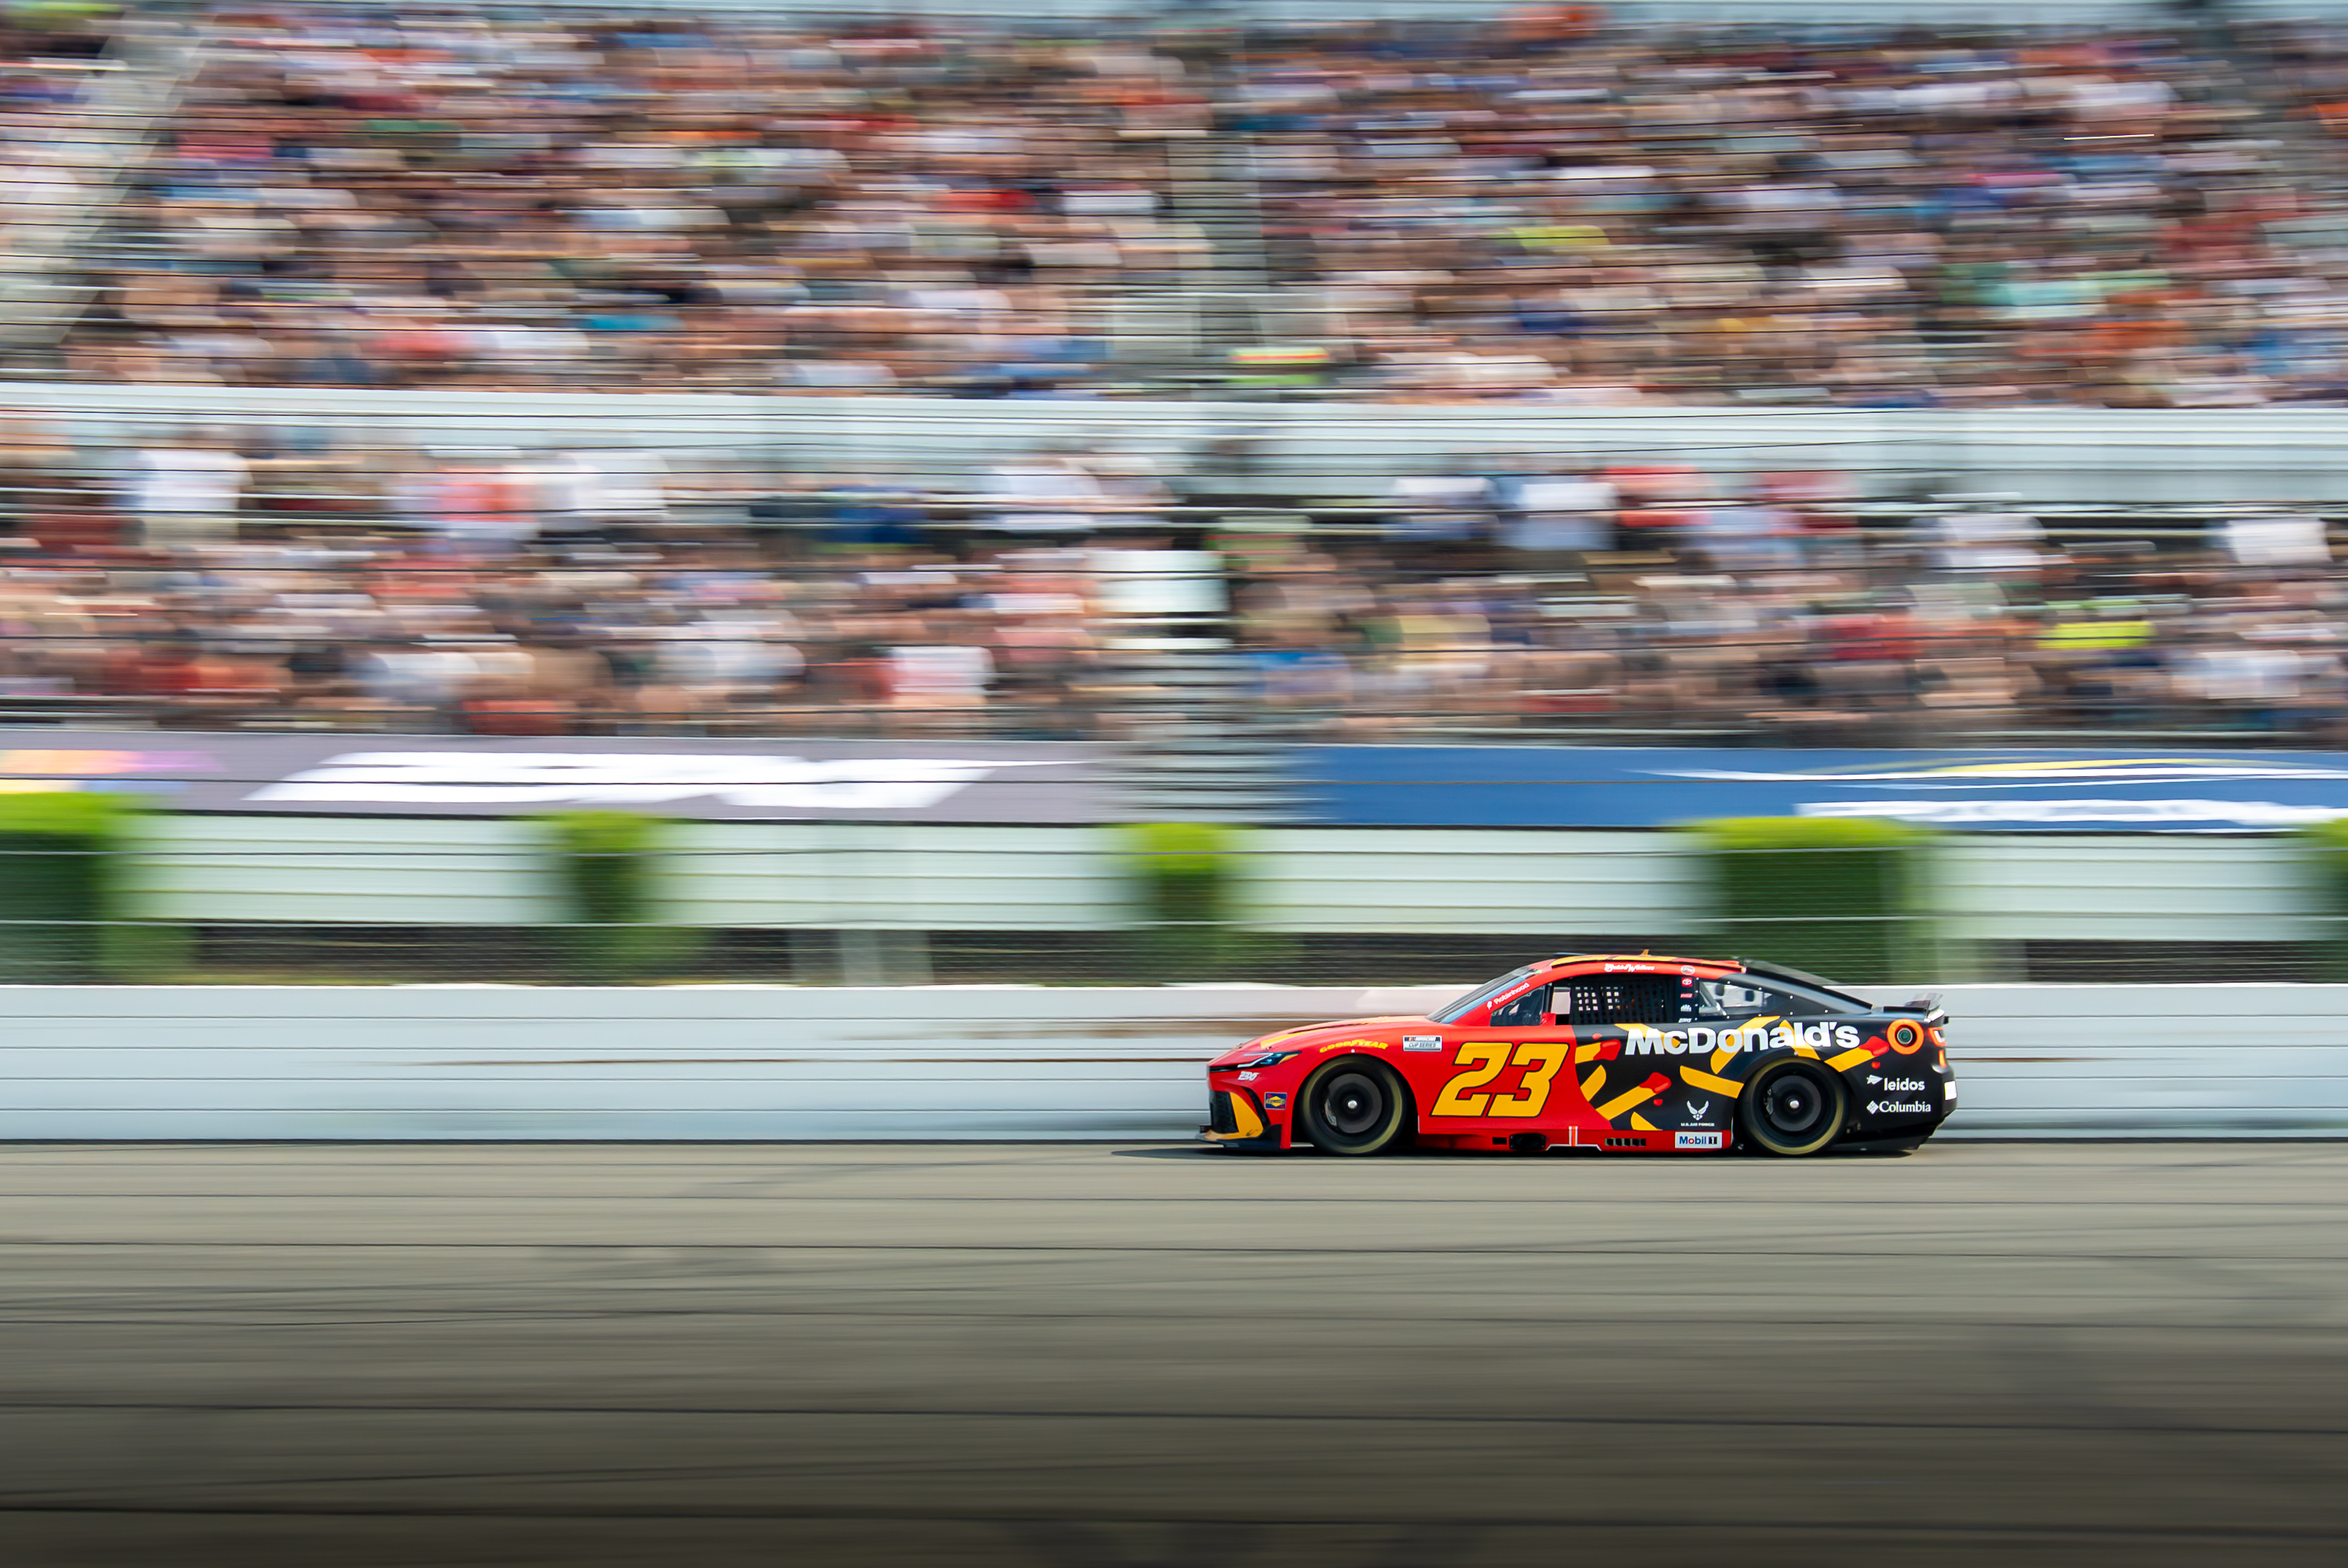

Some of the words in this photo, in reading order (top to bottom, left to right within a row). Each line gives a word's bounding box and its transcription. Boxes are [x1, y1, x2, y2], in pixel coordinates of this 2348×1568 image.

[1625, 1021, 1861, 1055] McDonald's
[1319, 1038, 1389, 1053] GOODYEAR
[1428, 1041, 1571, 1119] 23
[1884, 1077, 1925, 1091] leidos
[1879, 1100, 1931, 1113] Columbia
[1679, 1136, 1707, 1145] Mobil
